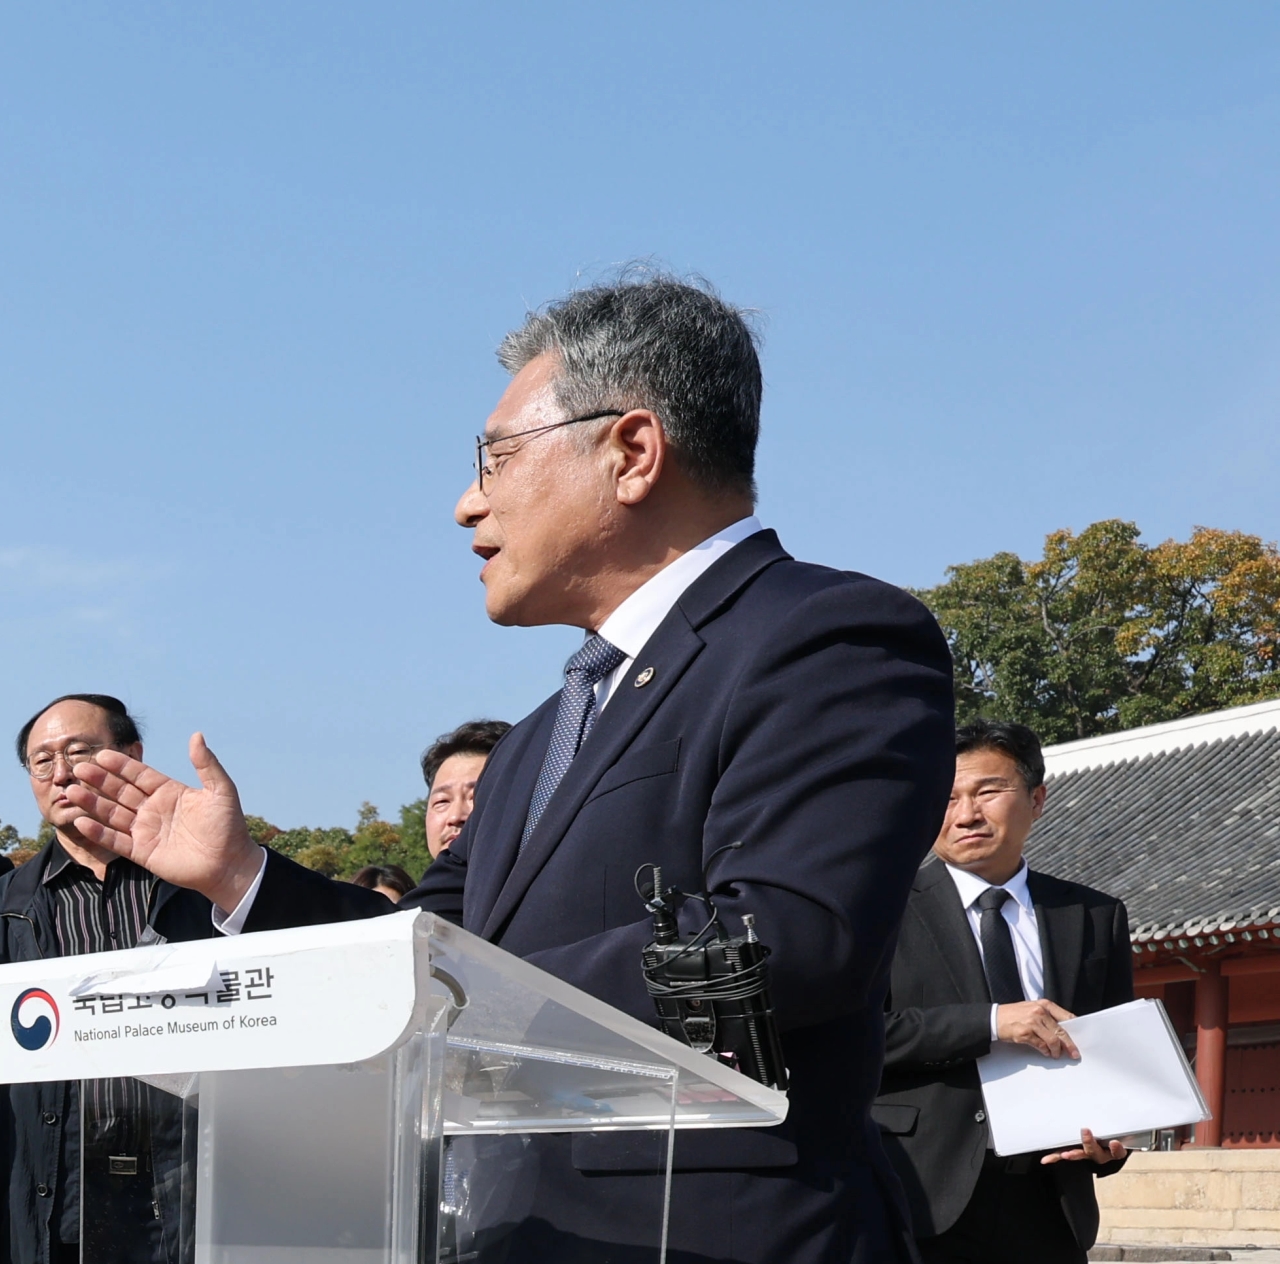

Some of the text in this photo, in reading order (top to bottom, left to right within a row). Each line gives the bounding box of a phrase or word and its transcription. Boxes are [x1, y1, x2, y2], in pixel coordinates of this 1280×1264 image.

[74, 1014, 277, 1042] National Palace Museum of Korea
